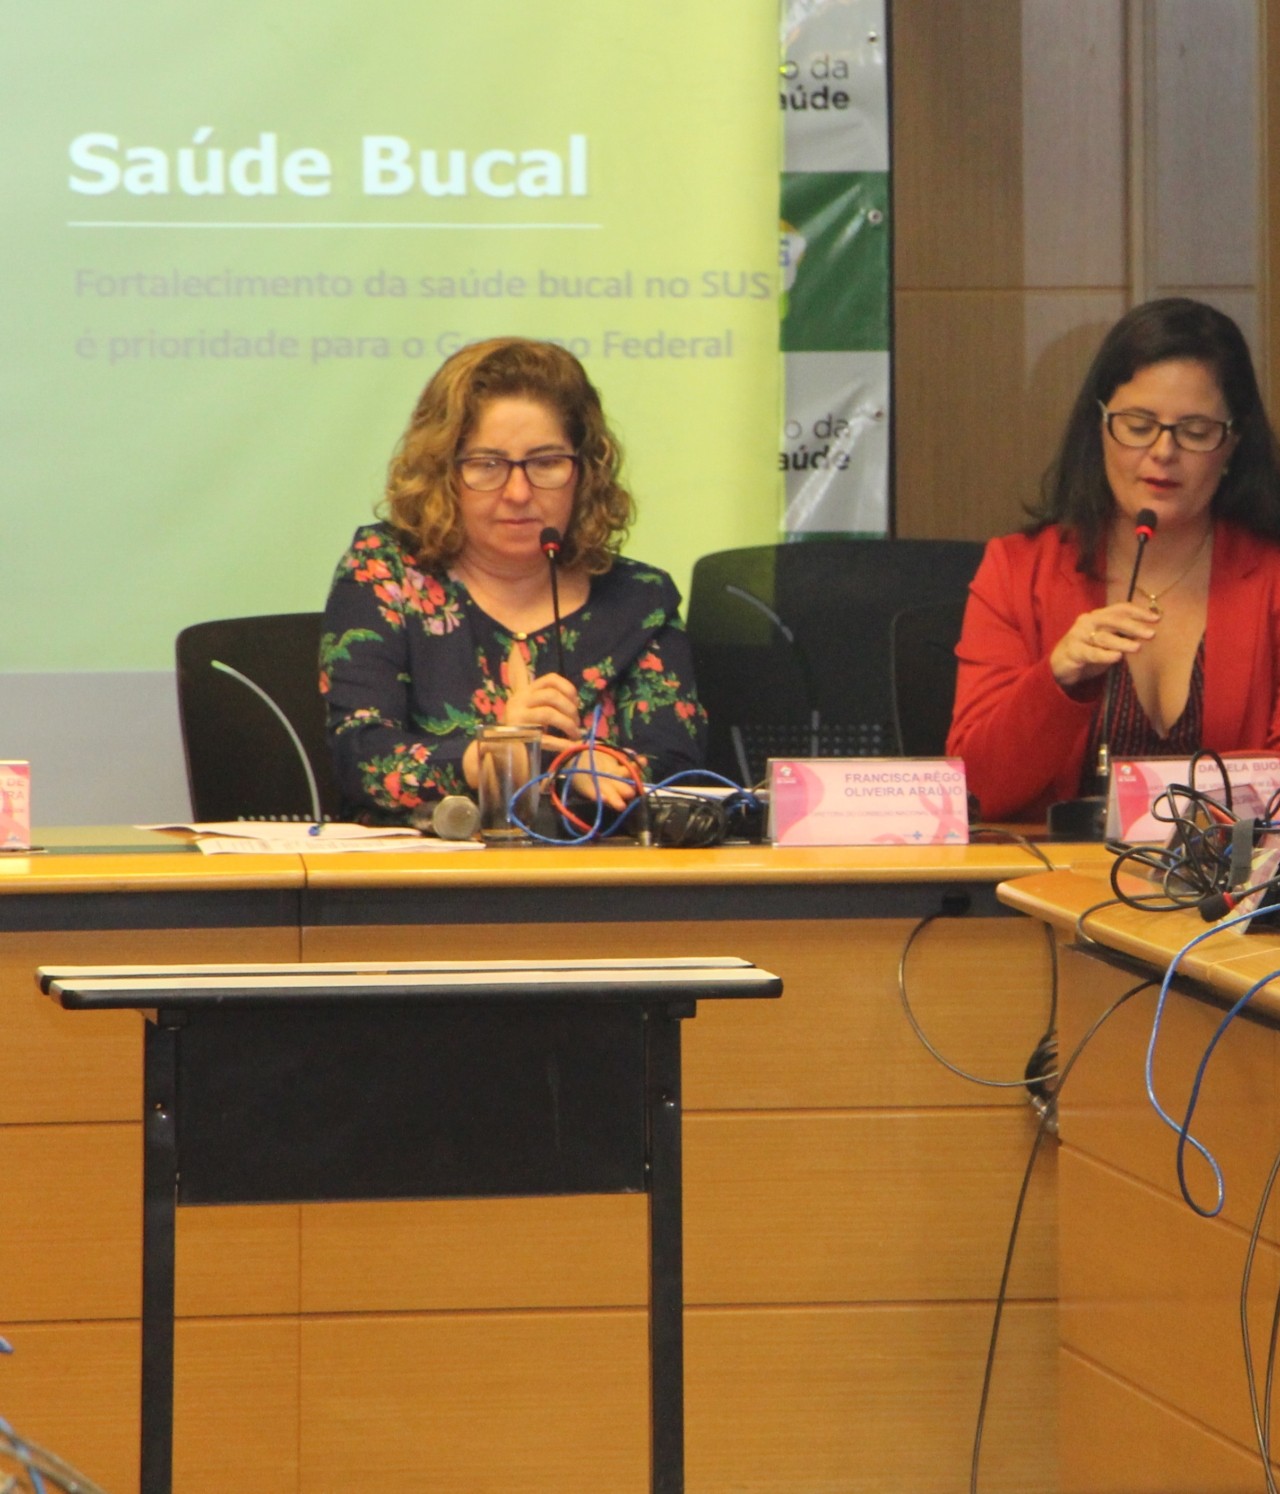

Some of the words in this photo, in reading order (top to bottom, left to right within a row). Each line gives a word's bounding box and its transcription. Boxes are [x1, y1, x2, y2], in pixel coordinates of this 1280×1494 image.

[811, 53, 849, 80] da
[779, 84, 850, 110] aúde
[68, 126, 332, 196] Saúde
[361, 133, 588, 196] Bucal
[74, 268, 354, 298] Fortalecimento
[363, 269, 408, 298] da
[420, 268, 527, 298] saúde
[539, 270, 633, 299] bucal
[646, 278, 690, 299] no
[701, 271, 771, 300] SUS
[74, 329, 97, 359] é
[108, 329, 300, 365] prioridade
[311, 336, 391, 364] para
[401, 337, 425, 359] o
[602, 330, 734, 359] Federal
[813, 412, 850, 439] da
[778, 445, 850, 471] aúde
[845, 773, 920, 784] FRANCISCA
[1198, 762, 1250, 774] DAELA
[844, 787, 904, 798] OLIVEIRA
